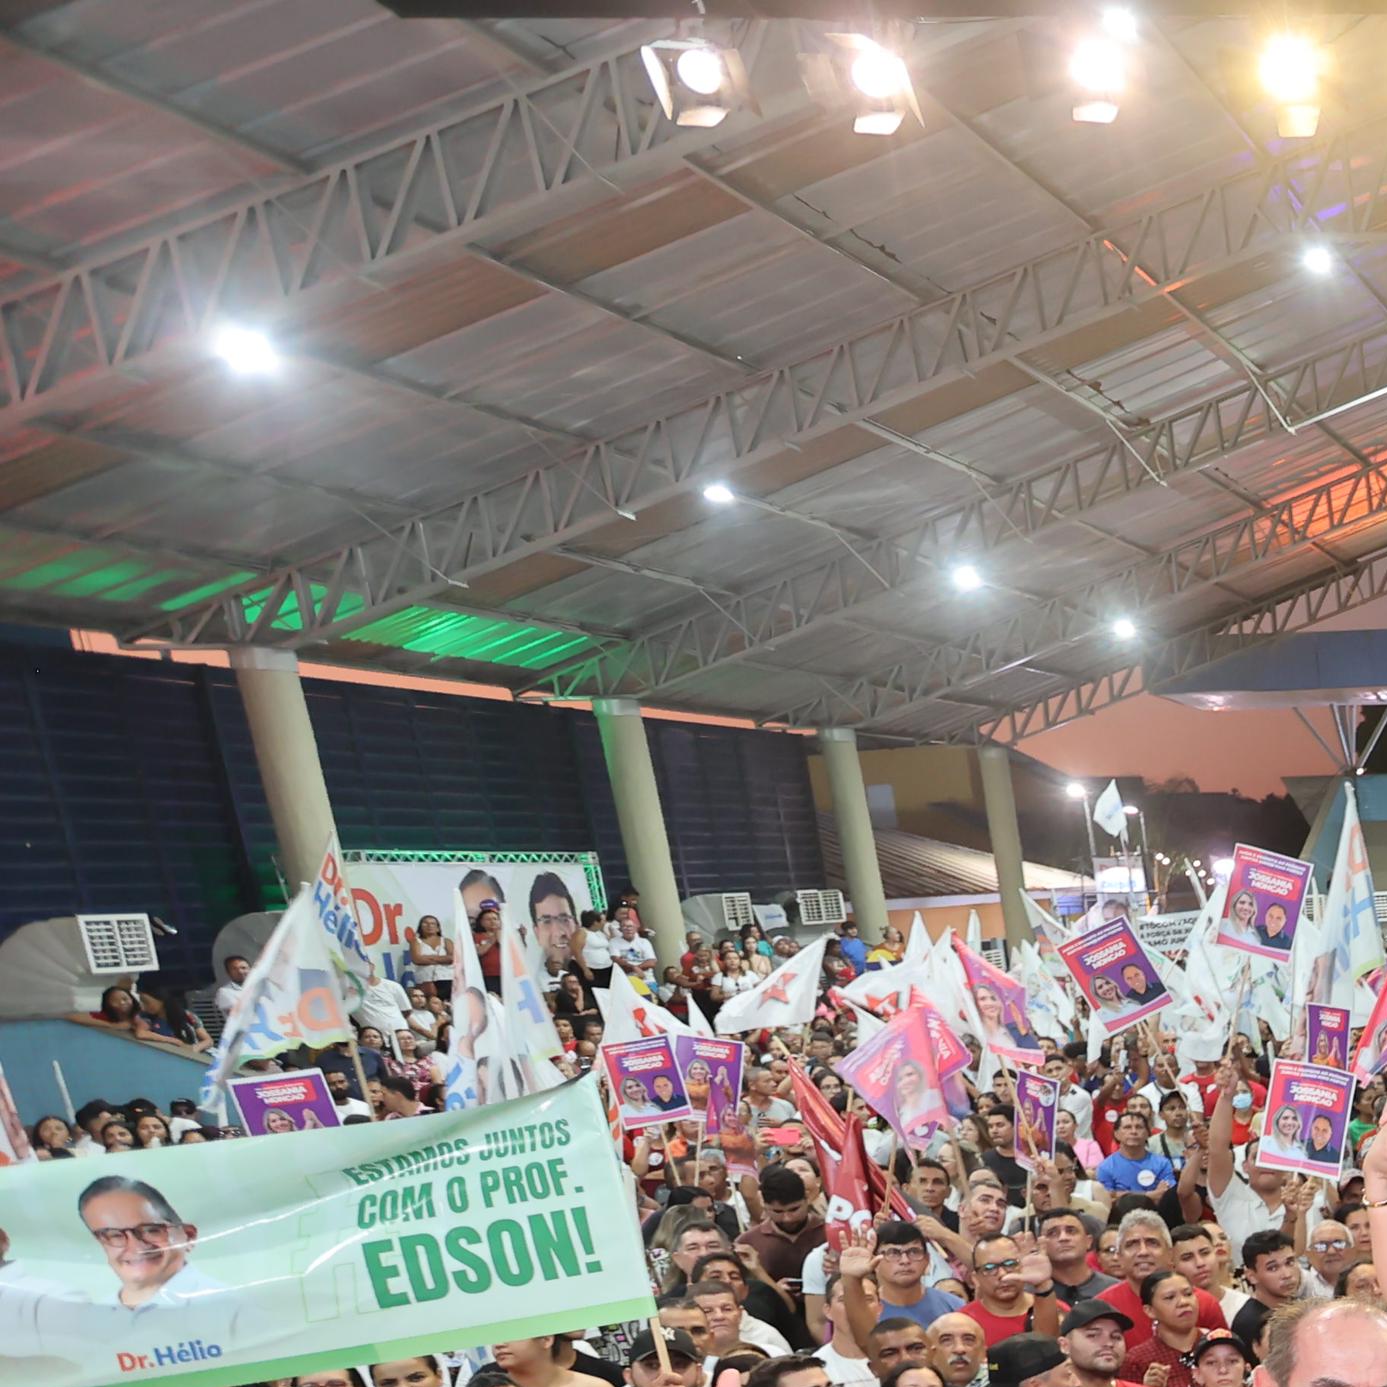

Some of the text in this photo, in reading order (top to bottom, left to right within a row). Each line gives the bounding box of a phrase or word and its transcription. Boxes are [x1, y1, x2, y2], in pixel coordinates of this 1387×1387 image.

[342, 1118, 572, 1186] ESTAMOS JUNTOS
[357, 1157, 584, 1229] COM O PROF.
[361, 1206, 603, 1309] EDSON!
[116, 1339, 224, 1372] Dr.Hélio
